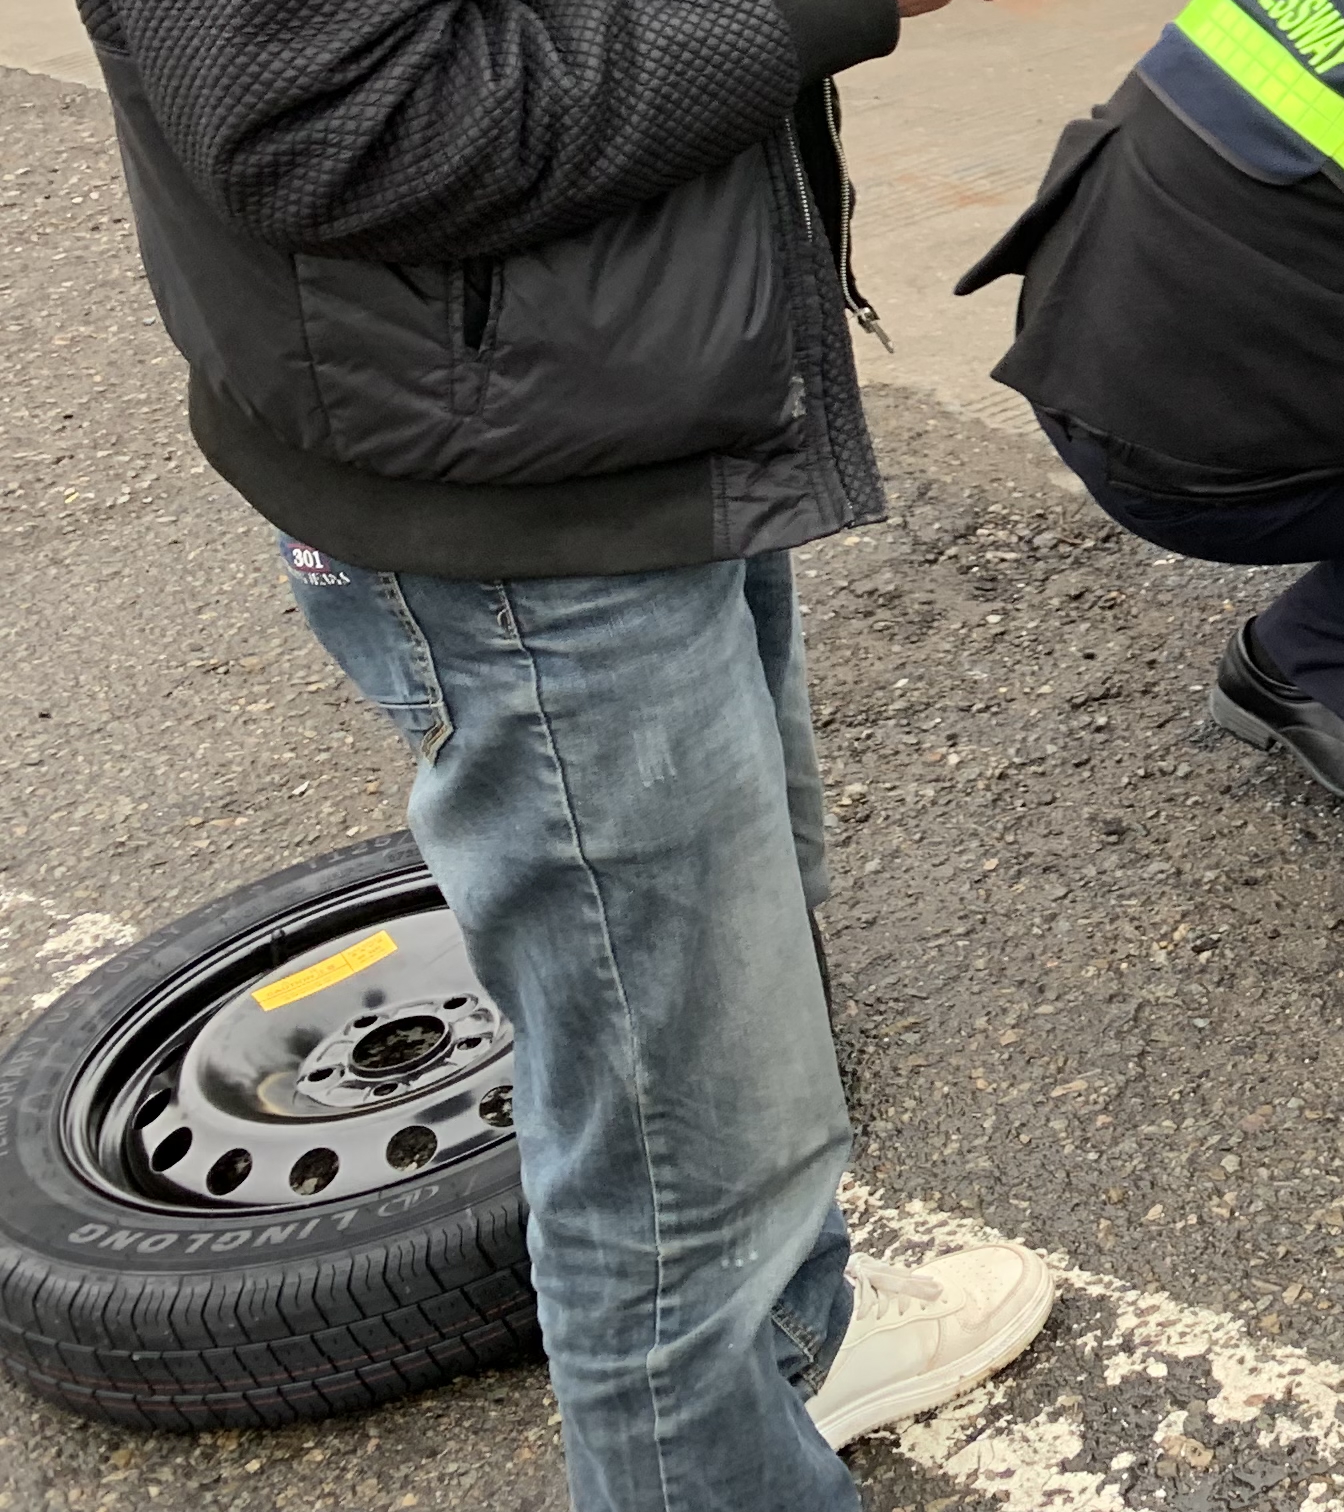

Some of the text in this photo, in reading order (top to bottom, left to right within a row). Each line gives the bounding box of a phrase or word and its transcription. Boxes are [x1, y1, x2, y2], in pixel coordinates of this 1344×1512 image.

[292, 548, 324, 569] 301
[44, 985, 103, 1024] USE
[104, 926, 181, 973] ONLY
[67, 1209, 360, 1255] LINGLONG
